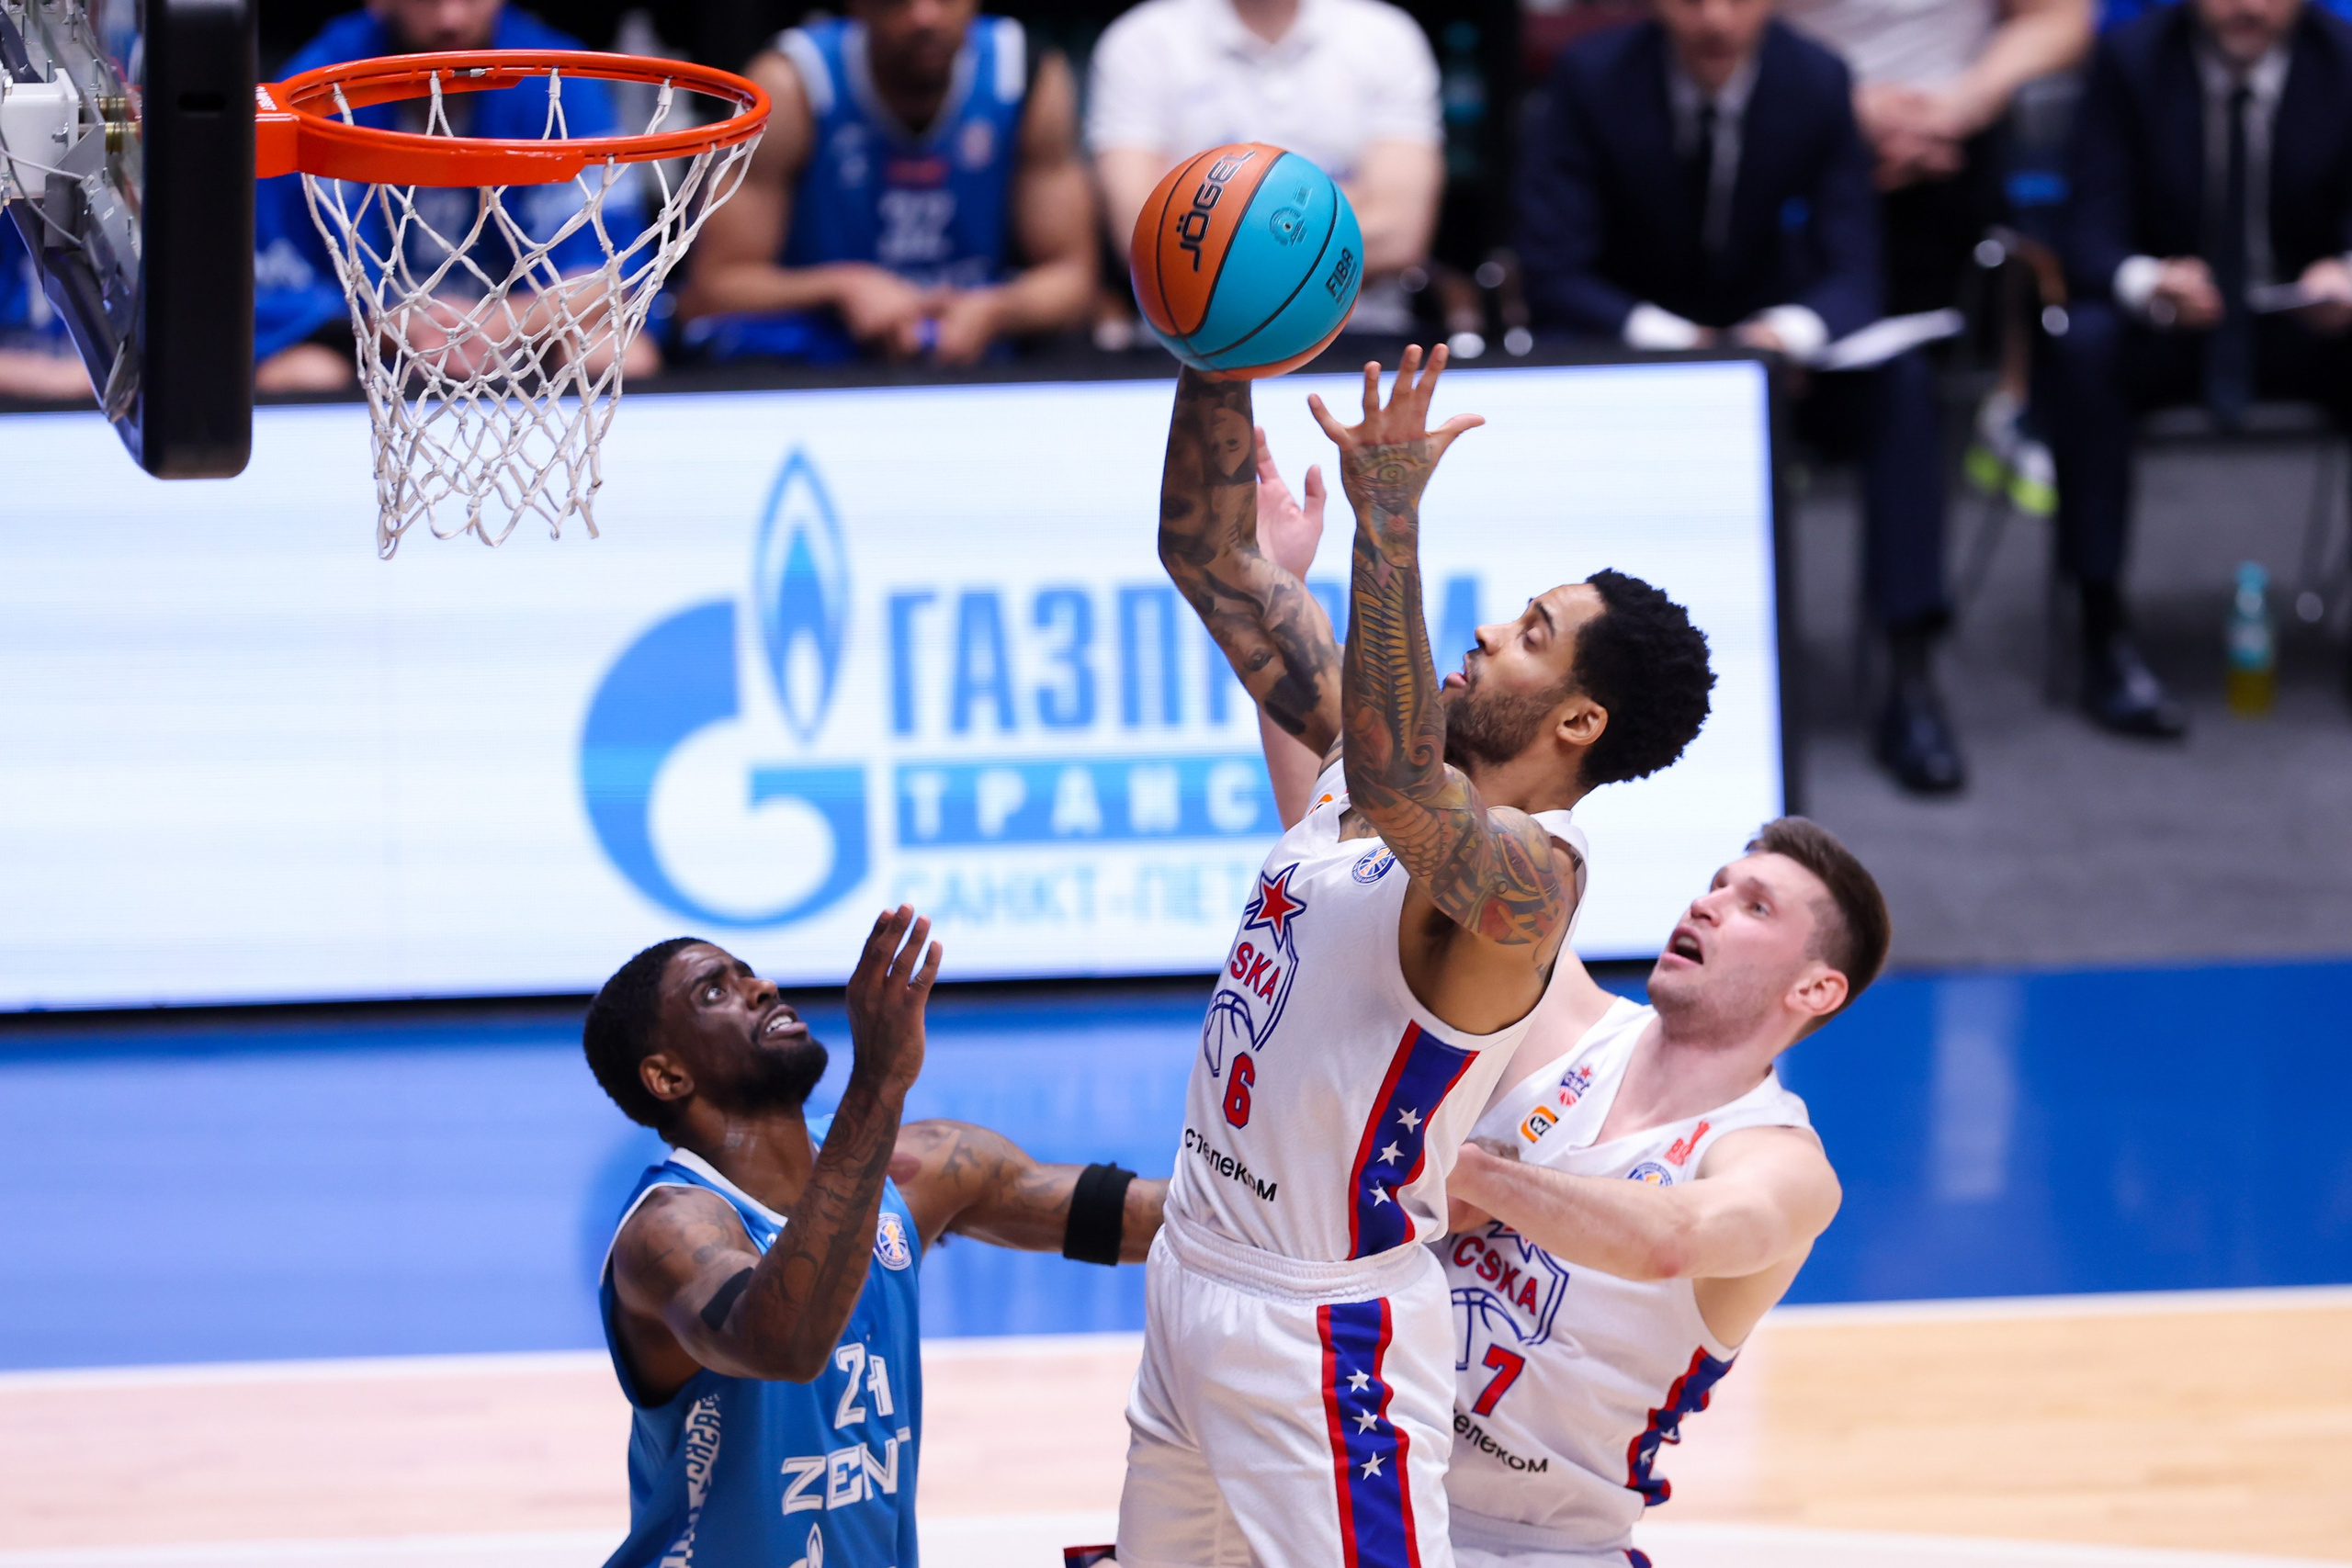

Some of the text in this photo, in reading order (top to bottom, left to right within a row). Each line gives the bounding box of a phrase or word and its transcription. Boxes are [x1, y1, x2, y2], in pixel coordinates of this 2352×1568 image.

[1176, 149, 1257, 273] JÖGEL
[1325, 246, 1354, 298] FIBA
[1229, 941, 1282, 1006] SKA
[1223, 1051, 1256, 1130] 6
[1453, 1236, 1538, 1316] CSKA
[833, 1342, 895, 1430] 24
[1470, 1343, 1526, 1417] 7
[781, 1426, 911, 1517] ZEN
[1453, 1405, 1548, 1473] елеком
